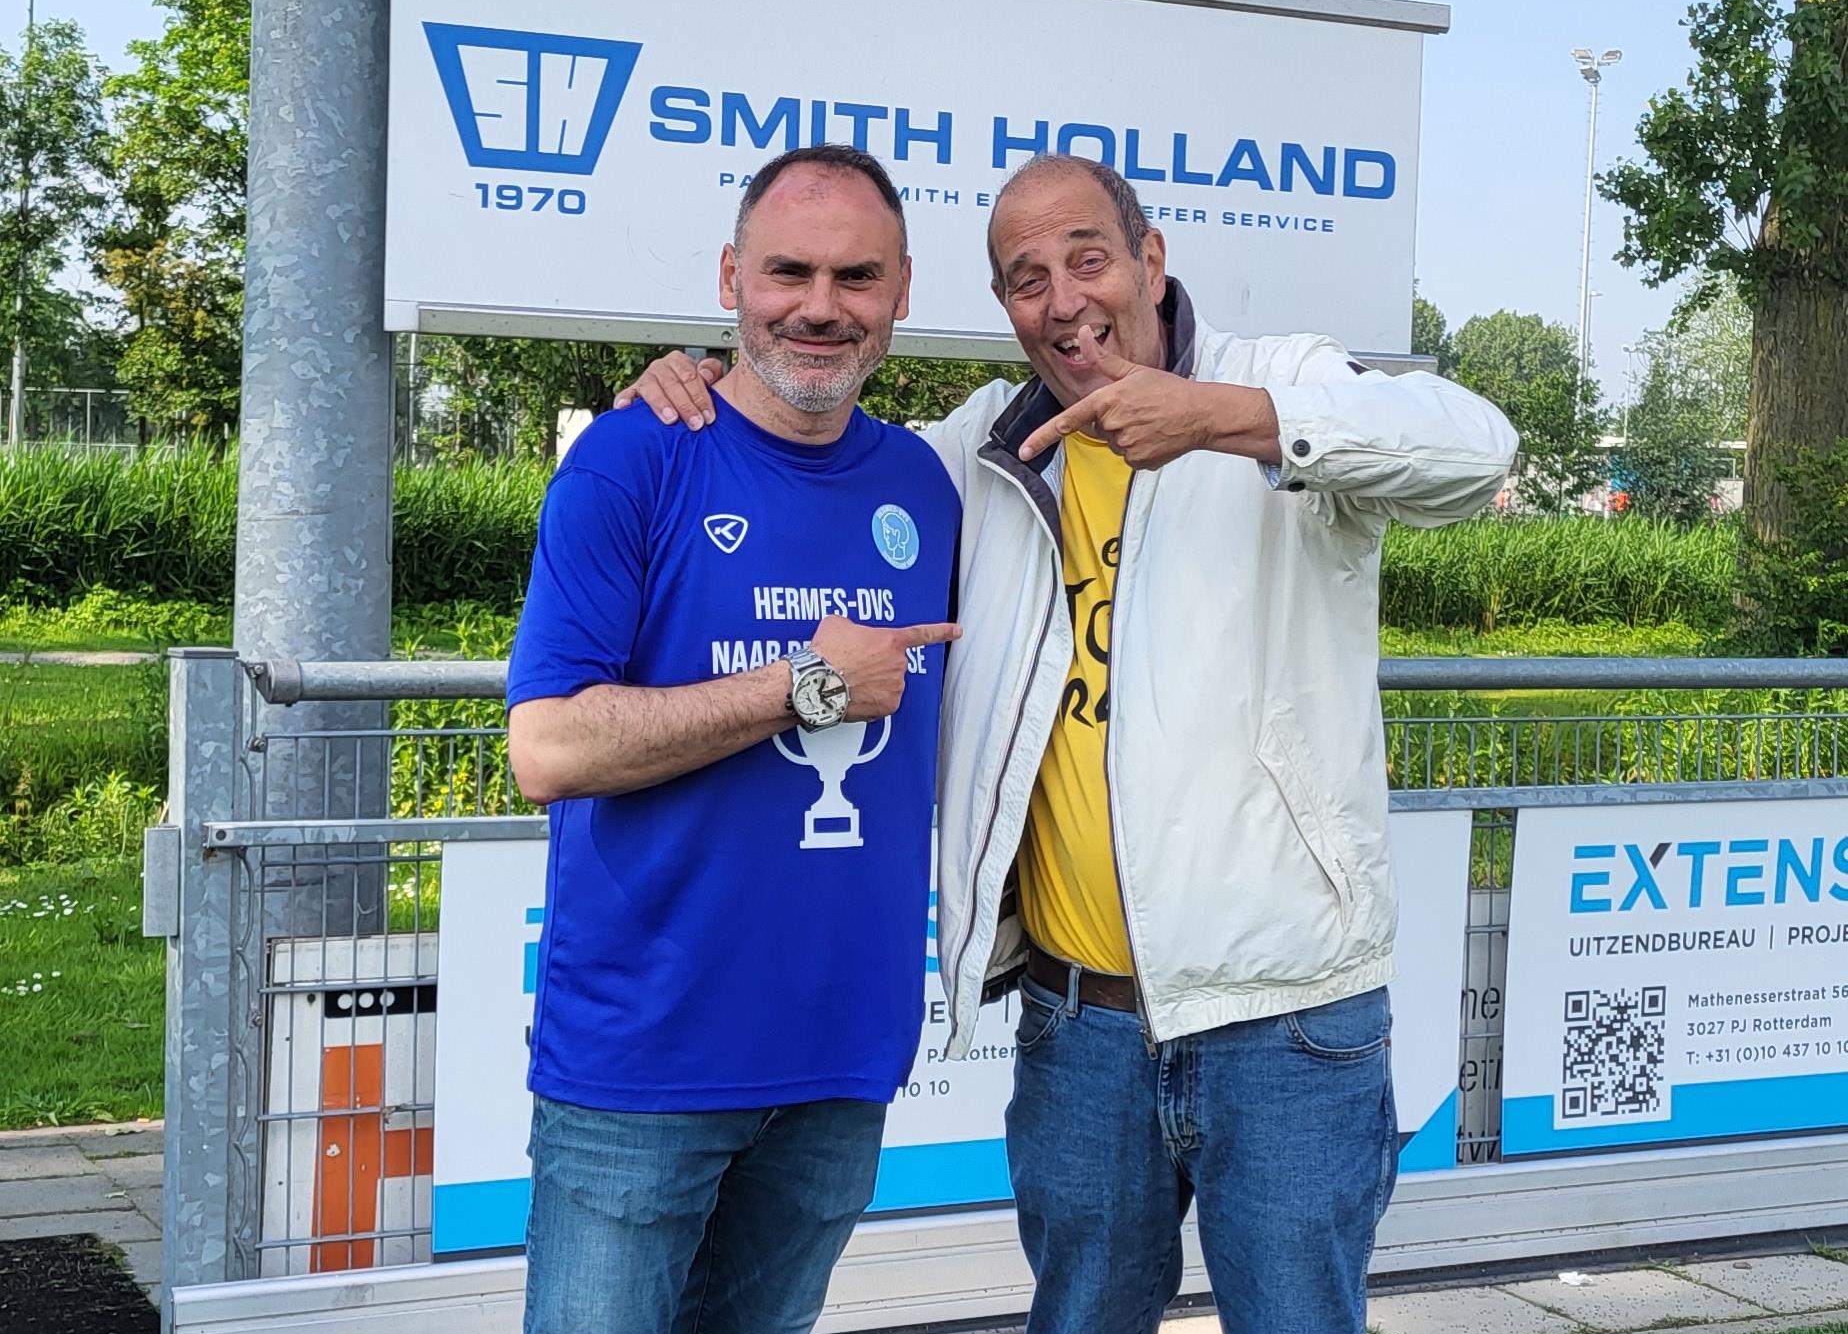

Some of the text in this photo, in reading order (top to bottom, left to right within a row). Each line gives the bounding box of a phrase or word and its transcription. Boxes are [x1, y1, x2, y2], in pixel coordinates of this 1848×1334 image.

[650, 85, 1398, 200] SMITH HOLLAND
[474, 182, 587, 216] 1970
[897, 186, 959, 205] MITH
[1222, 211, 1335, 233] SERVICE
[753, 586, 896, 622] HERMES-DVS
[1569, 928, 1756, 957] UITZENDBUREAU
[1688, 986, 1827, 1008] Mathenesserstraat
[1686, 1014, 1832, 1036] 3027 PJ Rotterdam
[1686, 1050, 1700, 1065] T:
[1705, 1049, 1730, 1063] +31
[1736, 1045, 1777, 1064] (0)10
[1782, 1042, 1810, 1058] 437
[1815, 1041, 1831, 1056] 10
[929, 1079, 951, 1096] 10
